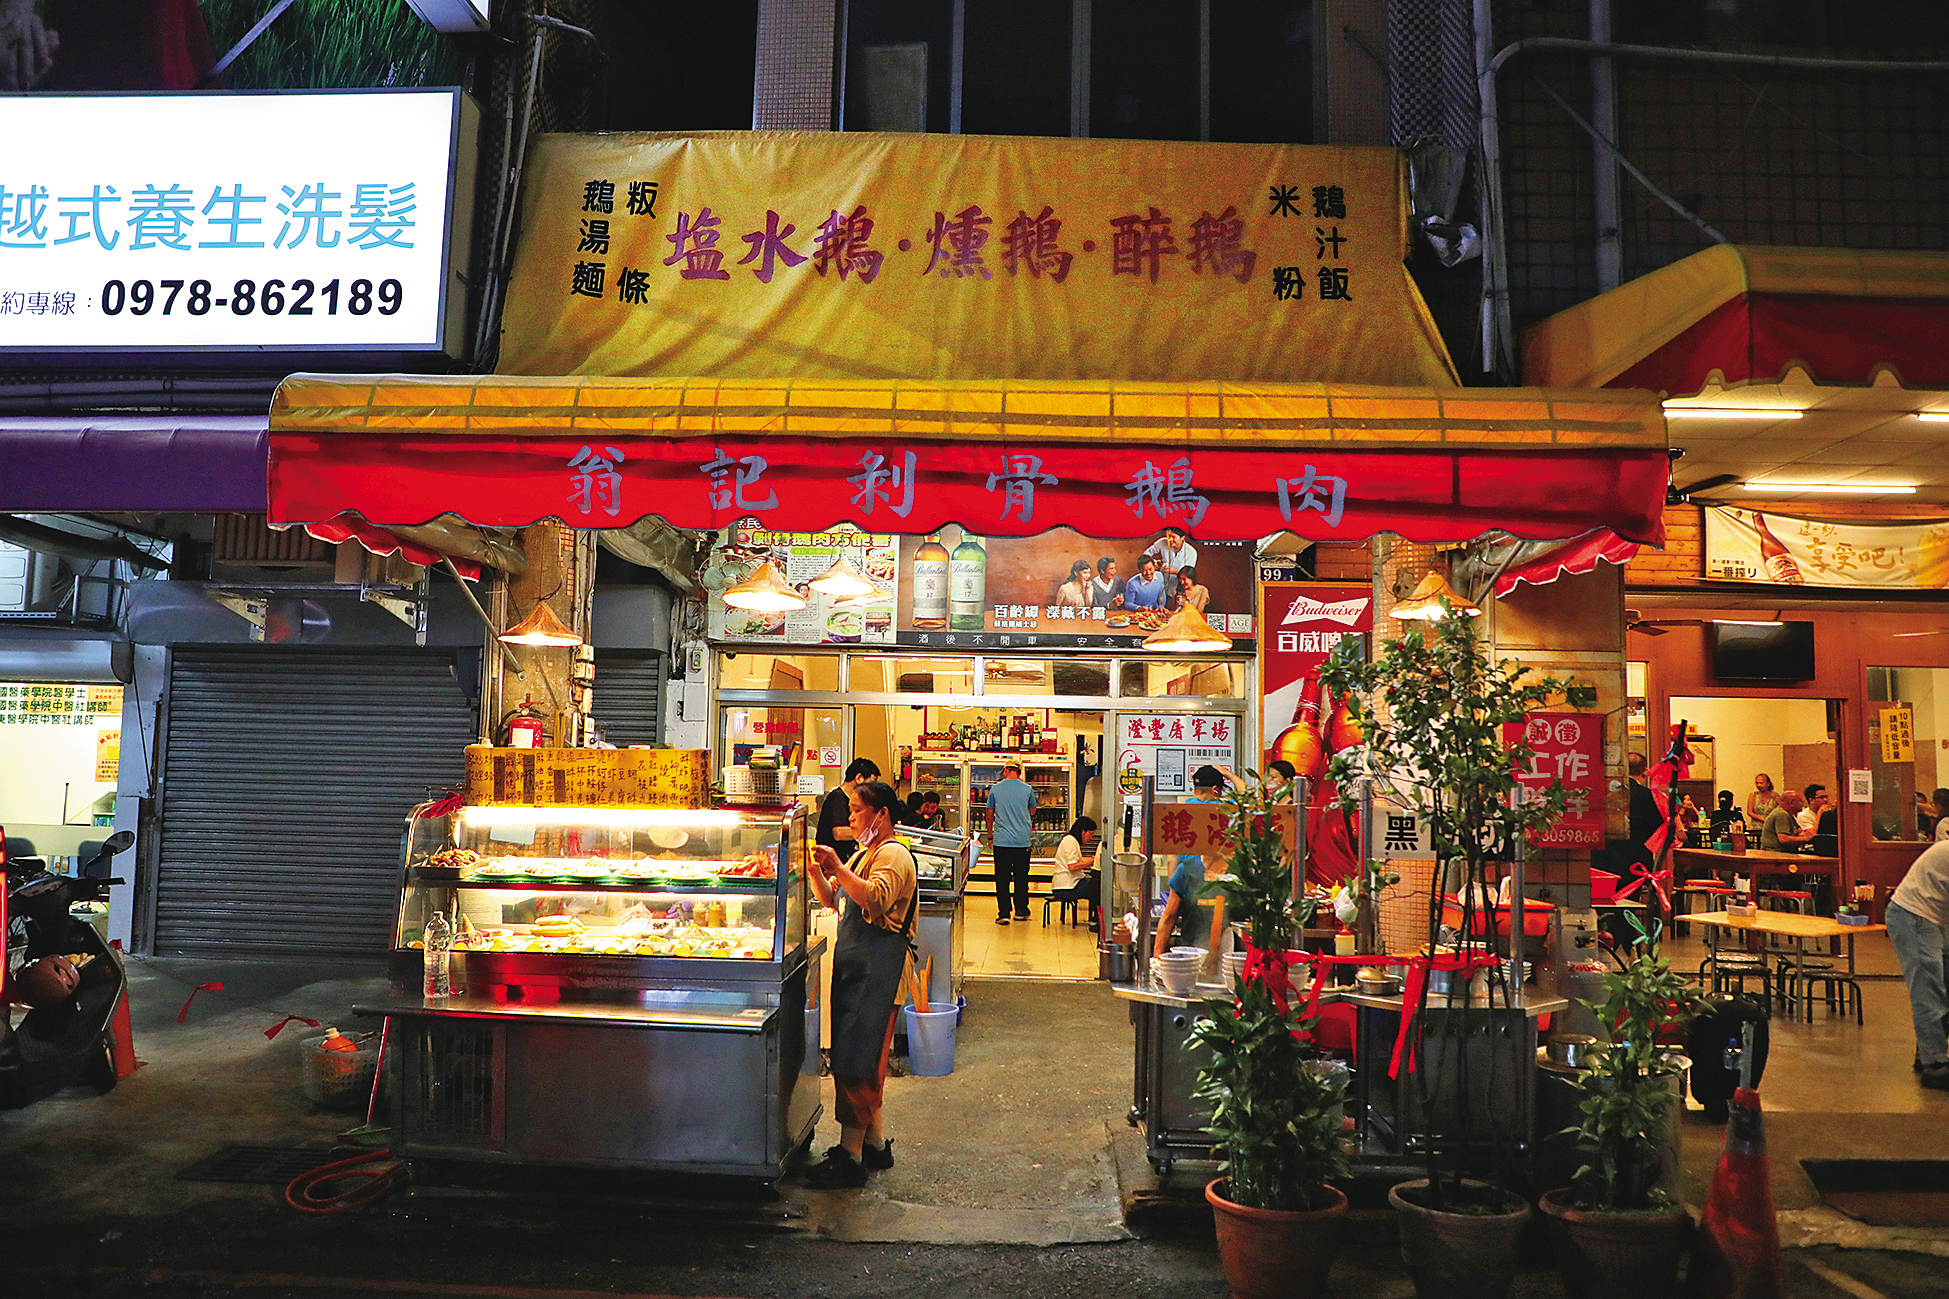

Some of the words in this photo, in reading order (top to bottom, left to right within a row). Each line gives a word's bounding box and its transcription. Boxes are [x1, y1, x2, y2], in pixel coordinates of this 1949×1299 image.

[0, 182, 415, 251] 越式養生洗髮
[570, 179, 615, 299] 鵝湯麵
[617, 180, 659, 305] 粄條
[1269, 184, 1306, 301] 米粉
[1312, 184, 1353, 302] 鵝汁飯
[101, 278, 403, 316] 0978-862189
[737, 518, 762, 529] 民
[1712, 566, 1757, 578] 一番搾り
[1805, 536, 1905, 574] 享受吧！
[1046, 605, 1106, 620] 深藏不露
[1288, 602, 1363, 616] Budweiser
[918, 633, 1038, 646] 酒後不開車
[1276, 631, 1363, 653] 百威啤
[1898, 712, 1910, 748] 10點過後
[1518, 749, 1590, 781] 工作
